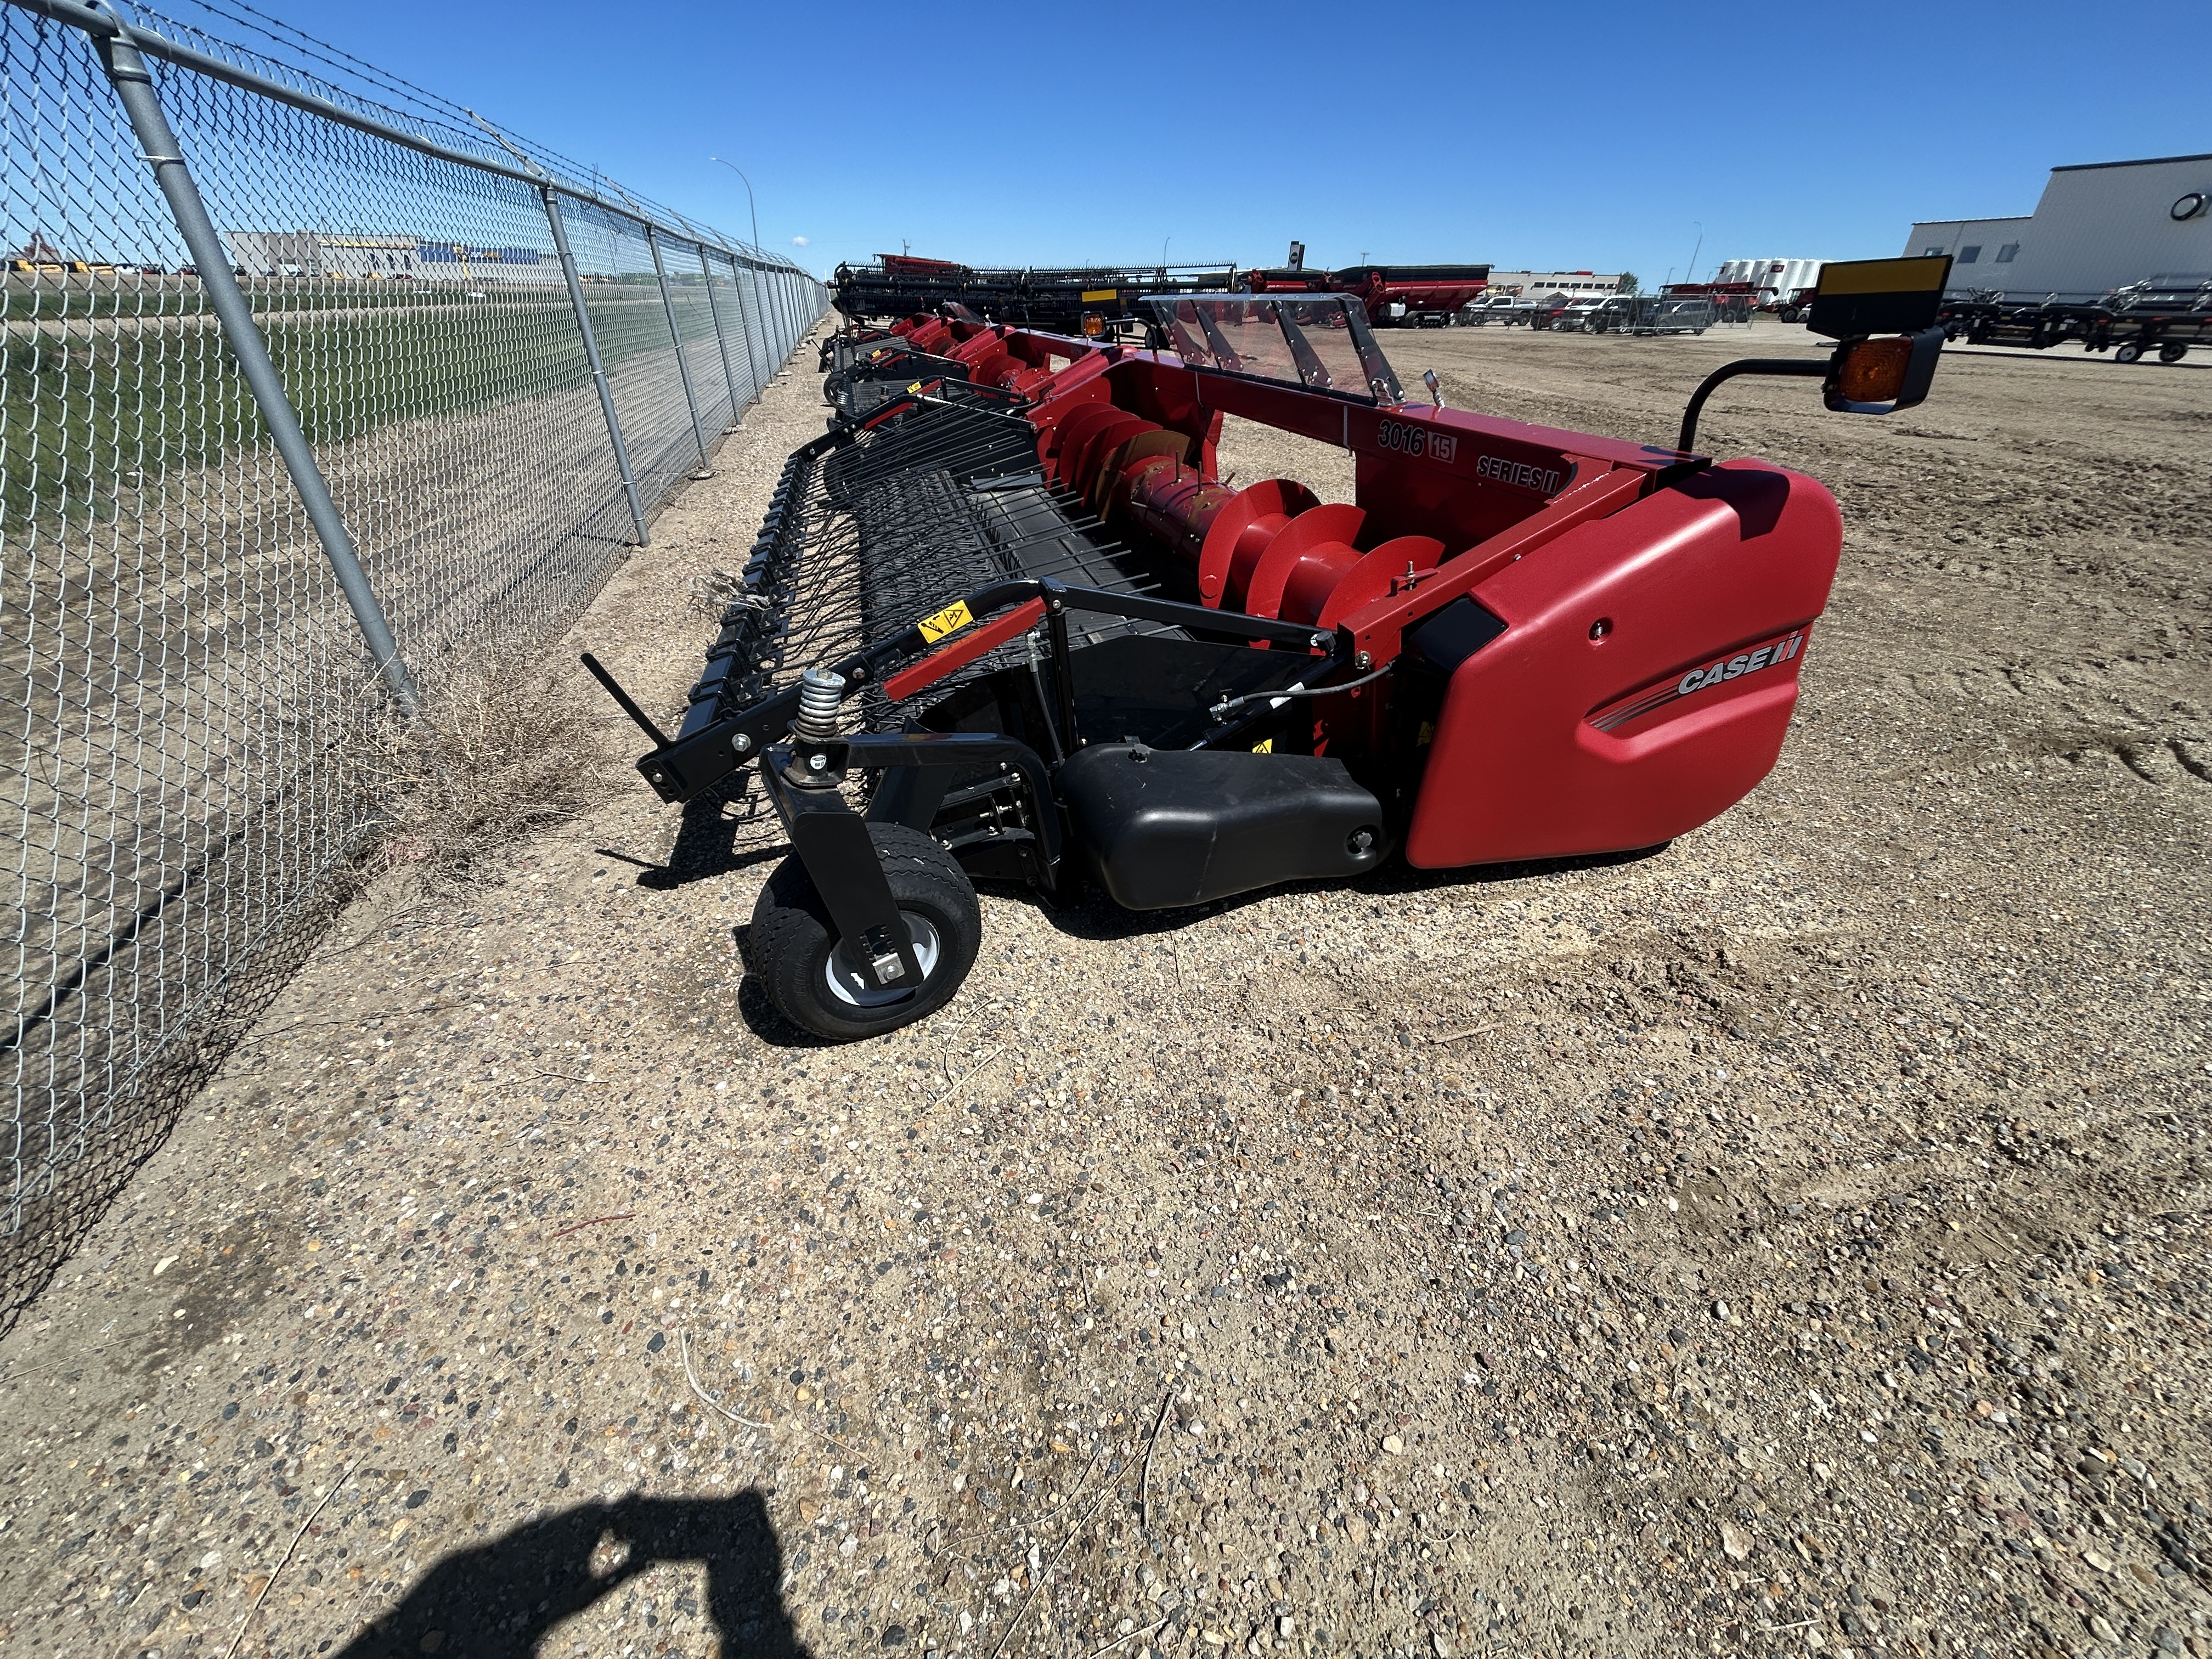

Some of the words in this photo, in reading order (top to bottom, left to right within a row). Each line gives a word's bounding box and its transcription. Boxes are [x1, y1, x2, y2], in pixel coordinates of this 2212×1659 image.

[1378, 419, 1425, 457] 3016
[1434, 437, 1450, 459] 15
[1476, 455, 1543, 490] SERIES
[1678, 645, 1773, 695] CASE
